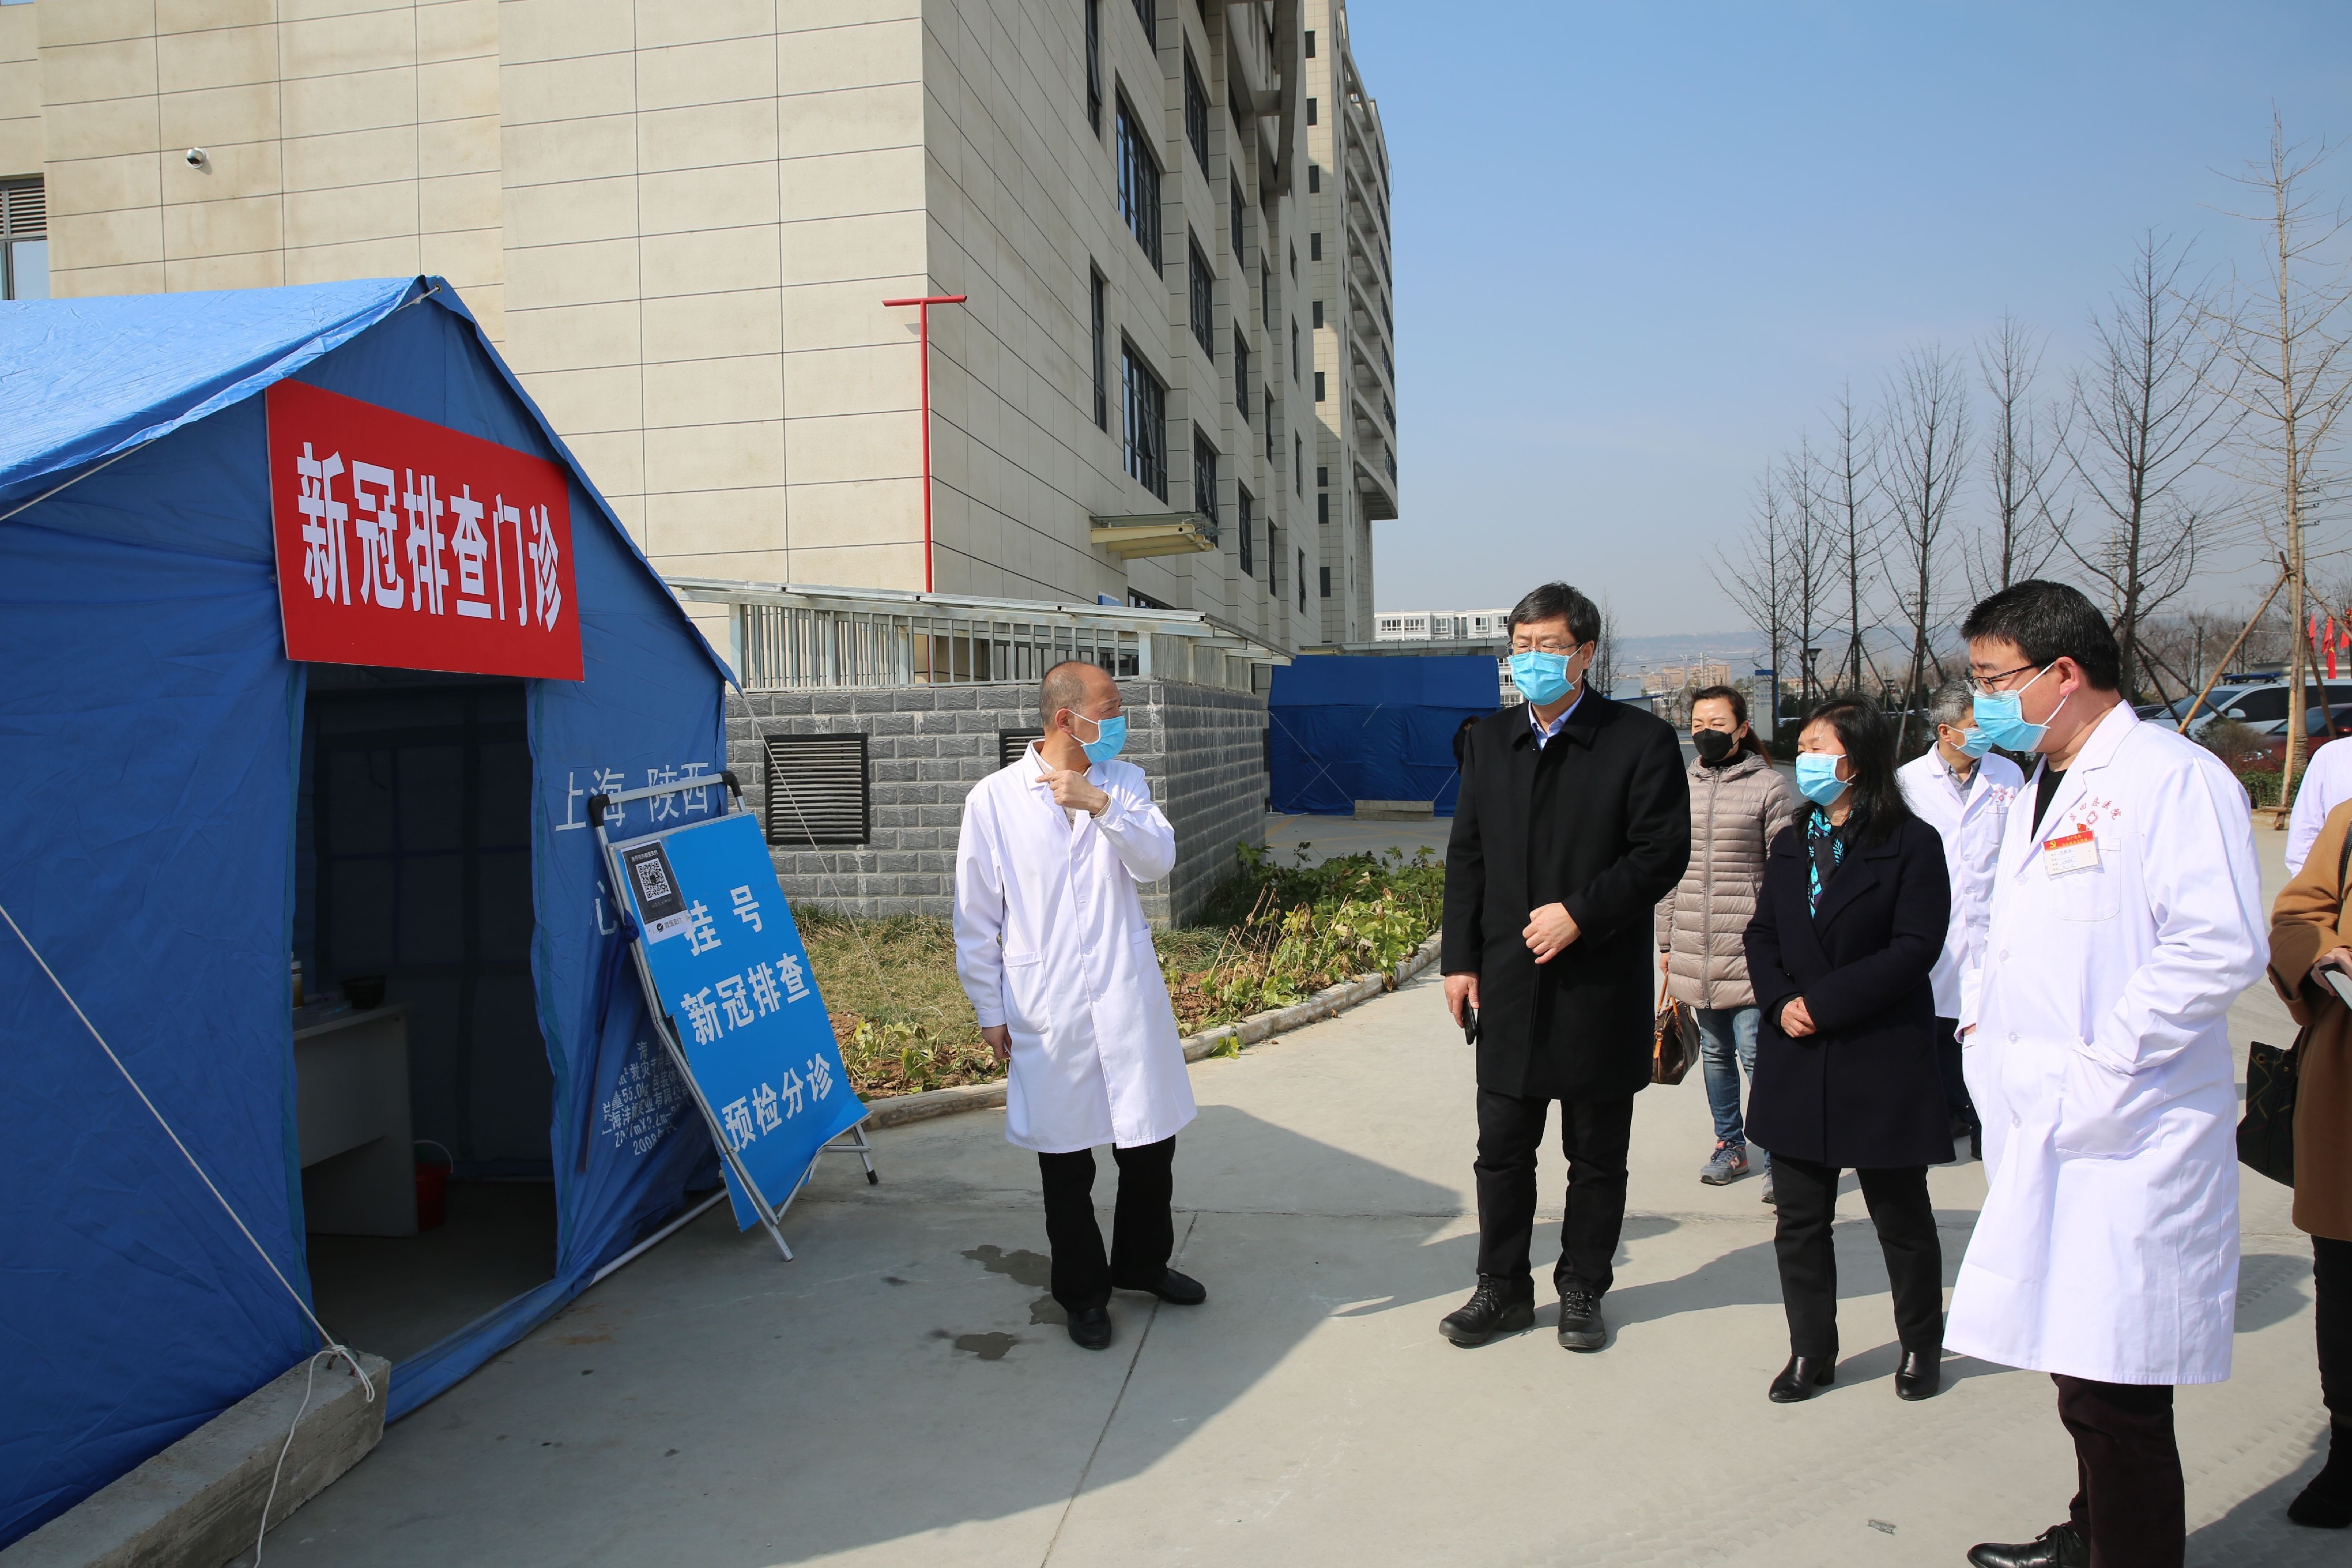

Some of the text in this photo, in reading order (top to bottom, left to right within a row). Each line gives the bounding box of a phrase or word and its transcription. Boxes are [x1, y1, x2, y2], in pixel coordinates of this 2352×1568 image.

[296, 442, 562, 633] 新冠排查门诊
[555, 762, 709, 832] 上海 陕西
[684, 884, 762, 956] 挂号
[680, 953, 810, 1045] 新冠排查
[721, 1053, 835, 1153] 预检分诊
